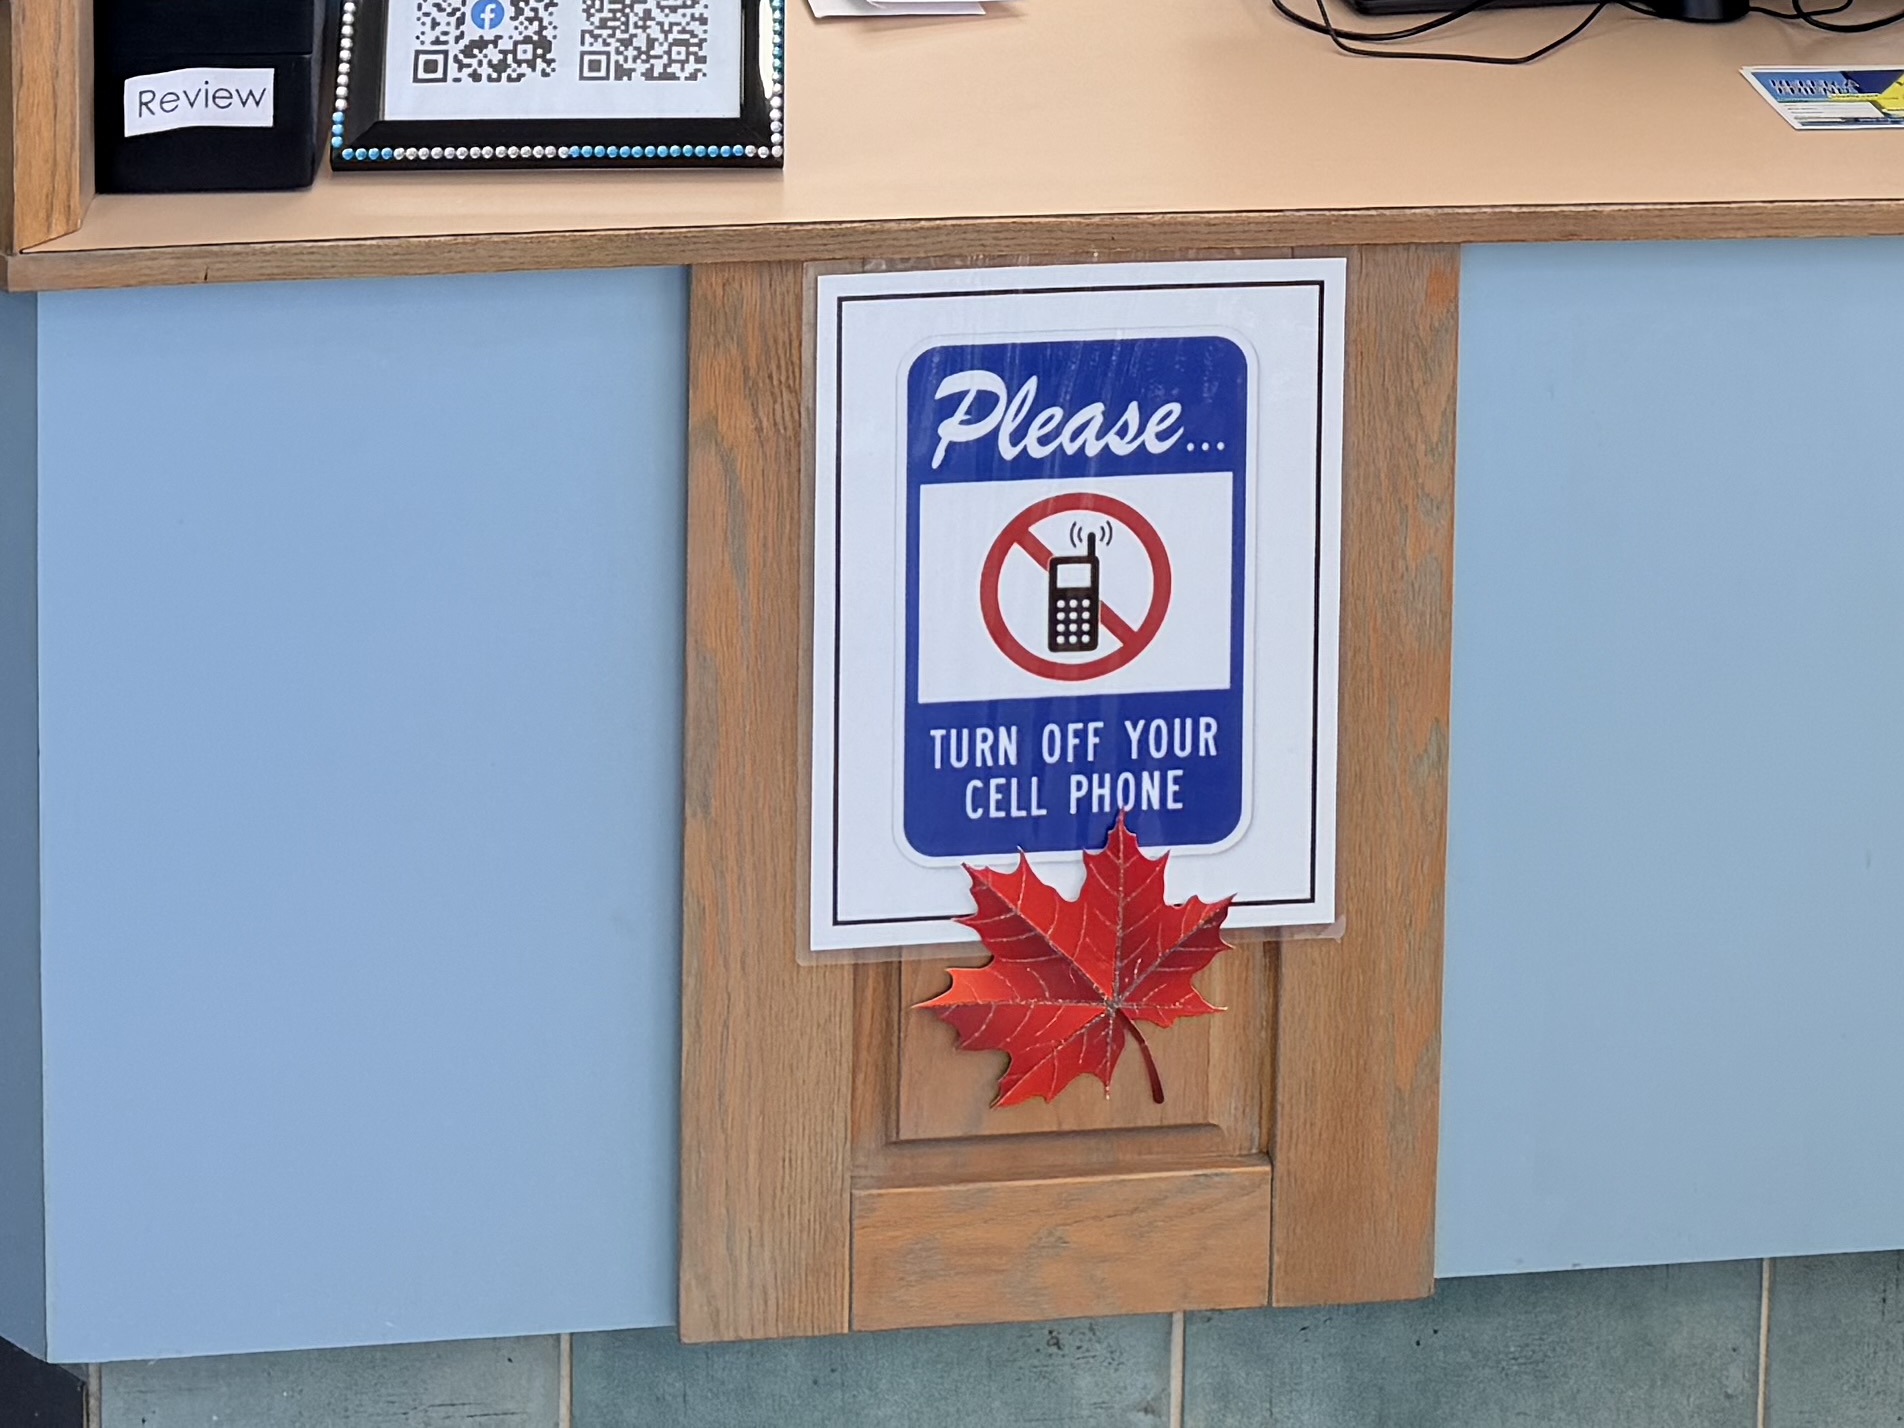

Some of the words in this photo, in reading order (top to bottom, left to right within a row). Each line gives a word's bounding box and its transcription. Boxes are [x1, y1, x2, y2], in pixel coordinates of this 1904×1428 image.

[138, 80, 267, 118] Review
[929, 726, 1018, 770] TURN
[1041, 721, 1105, 764] OFF
[1125, 716, 1219, 760] YOUR
[964, 775, 1047, 821] CELL
[1068, 769, 1185, 816] PHONE
